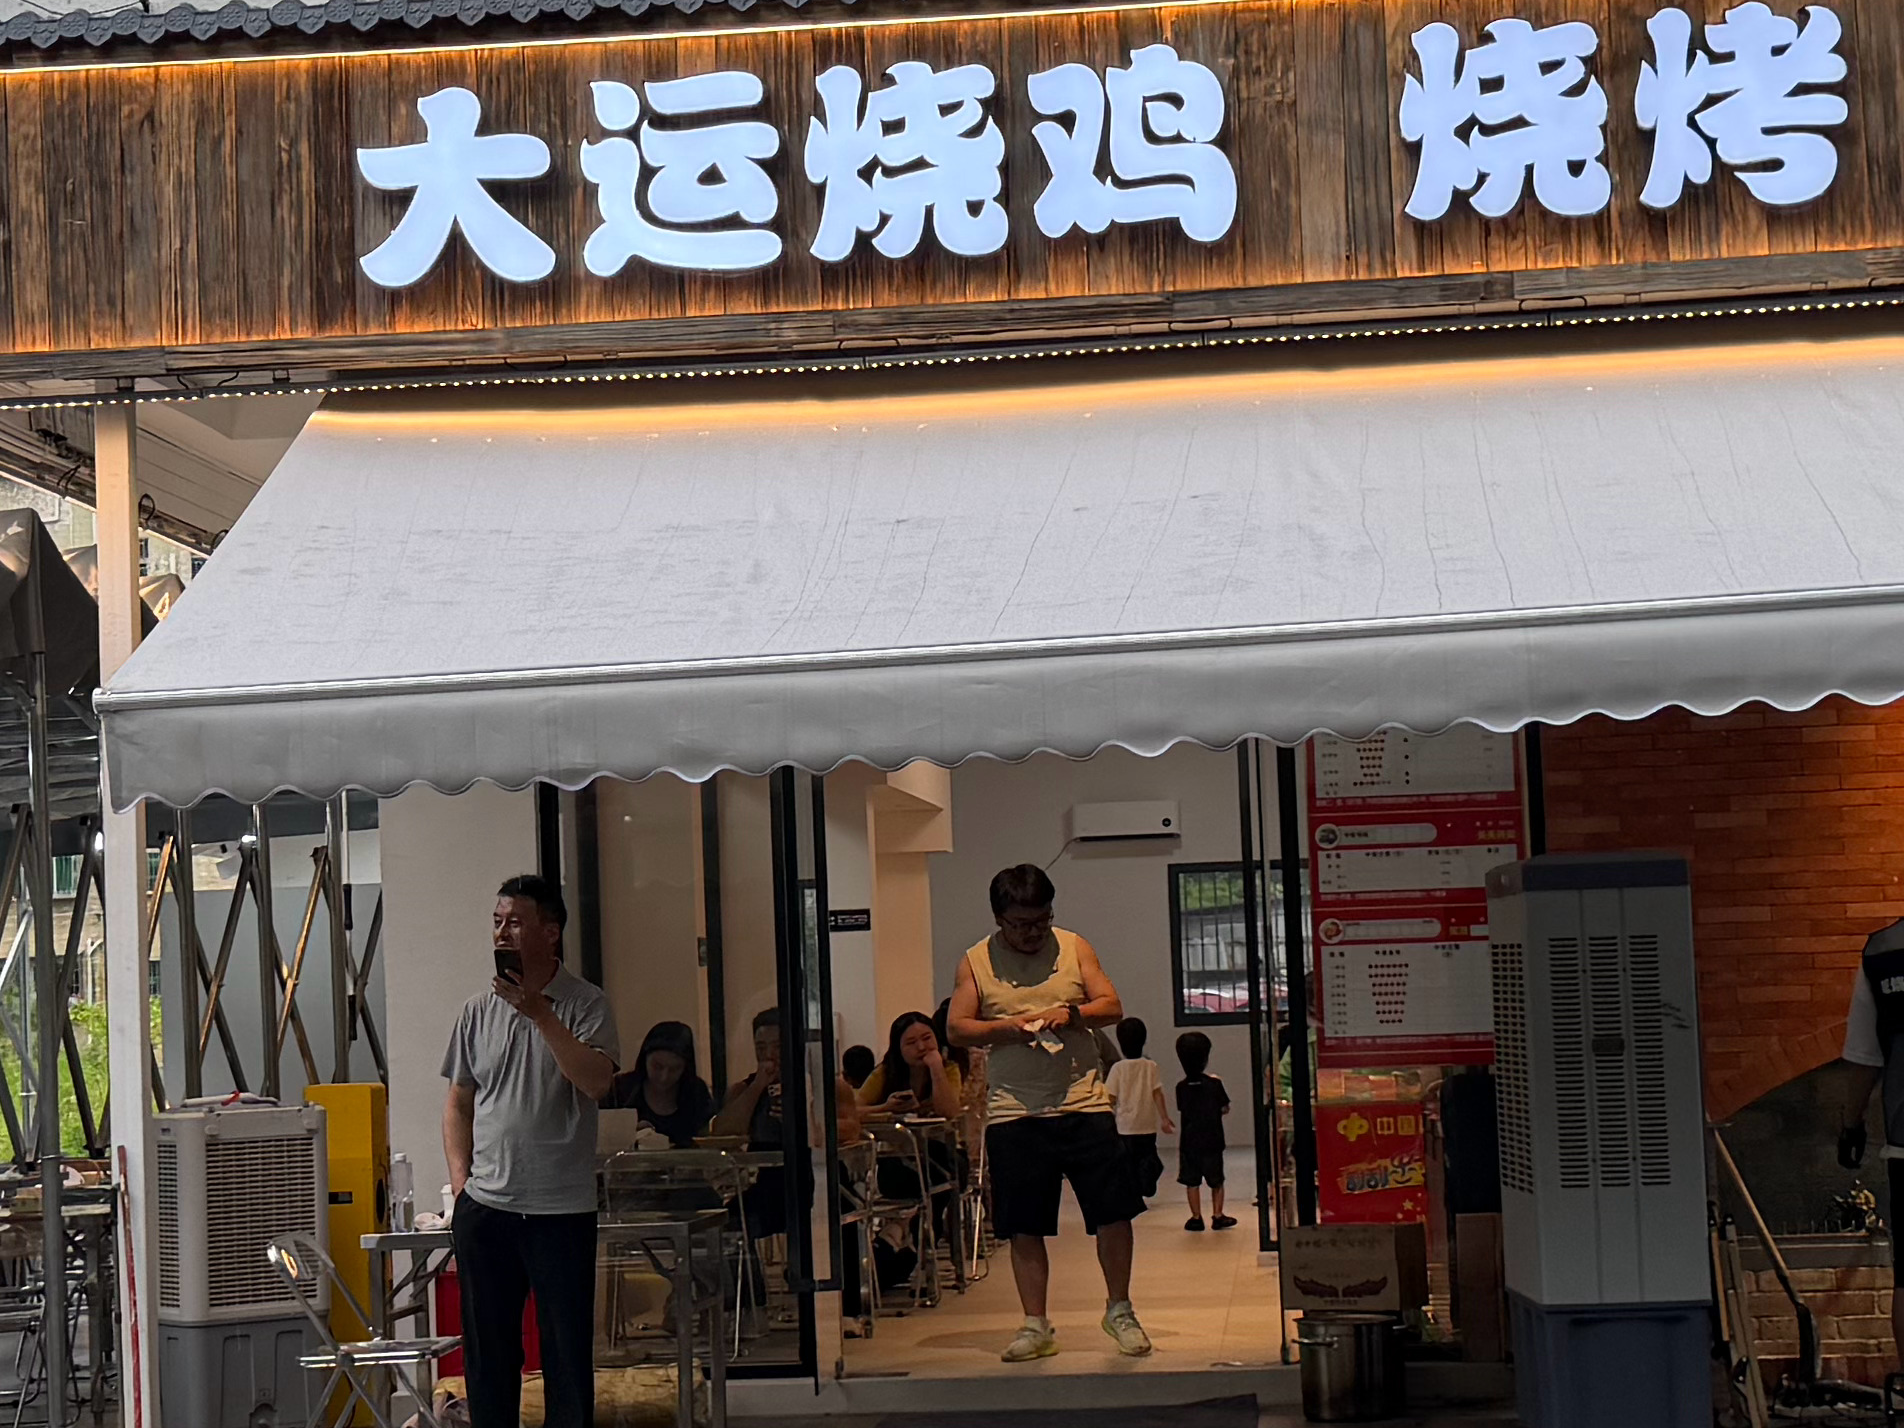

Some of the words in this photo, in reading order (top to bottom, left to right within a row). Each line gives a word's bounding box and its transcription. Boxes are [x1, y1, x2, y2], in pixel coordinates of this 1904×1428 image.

[357, 44, 1237, 286] 大运烧鸡
[1400, 2, 1847, 220] 烧烤
[1376, 1115, 1424, 1136] 中国
